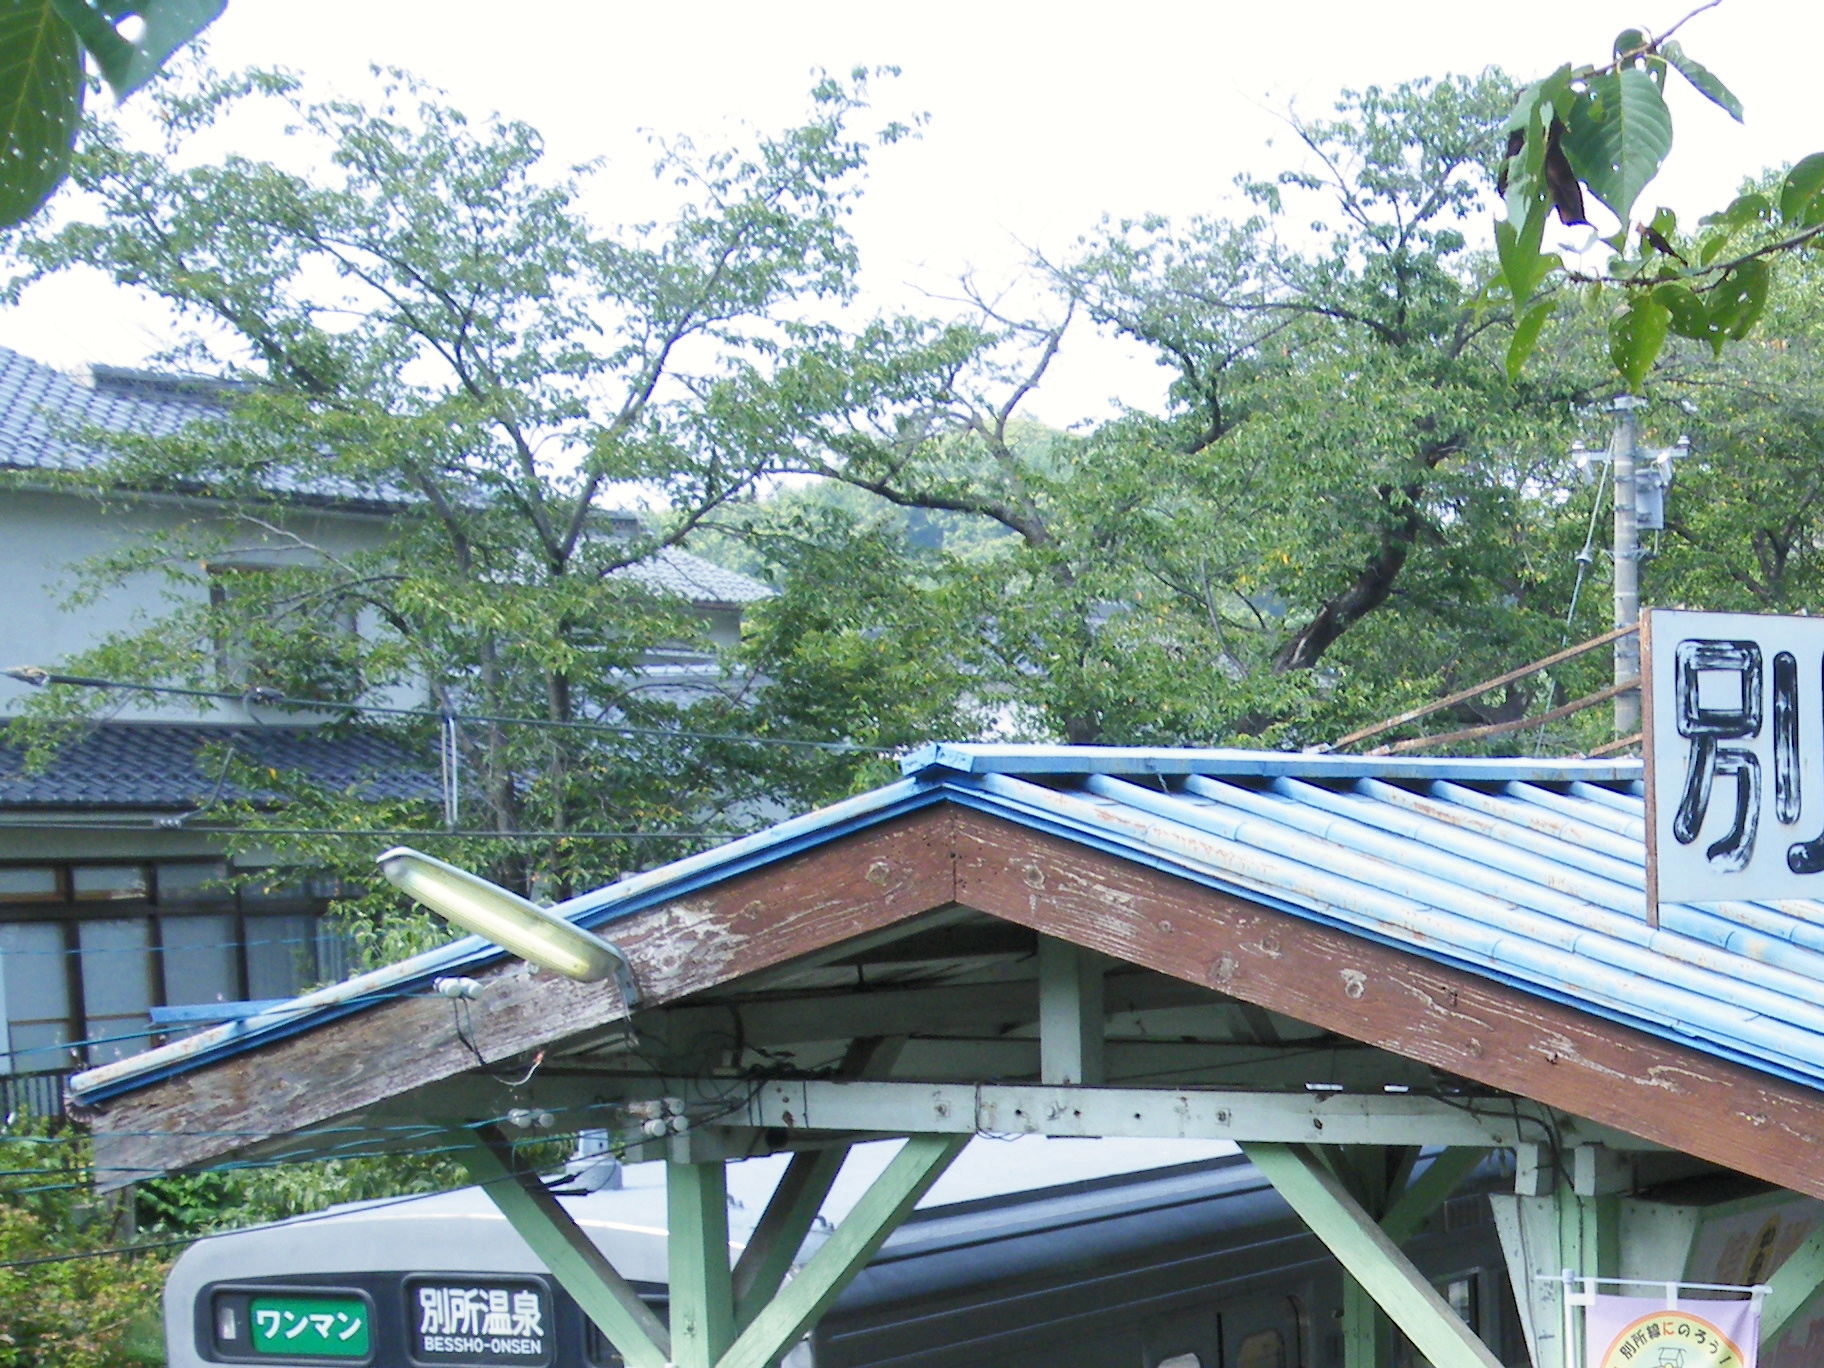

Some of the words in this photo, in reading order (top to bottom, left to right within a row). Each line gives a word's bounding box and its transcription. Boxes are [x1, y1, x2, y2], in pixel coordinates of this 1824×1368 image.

[255, 1308, 362, 1342] ワンマン
[418, 1287, 545, 1338] 別所温泉
[423, 1336, 544, 1355] BESSHO-ONSEN
